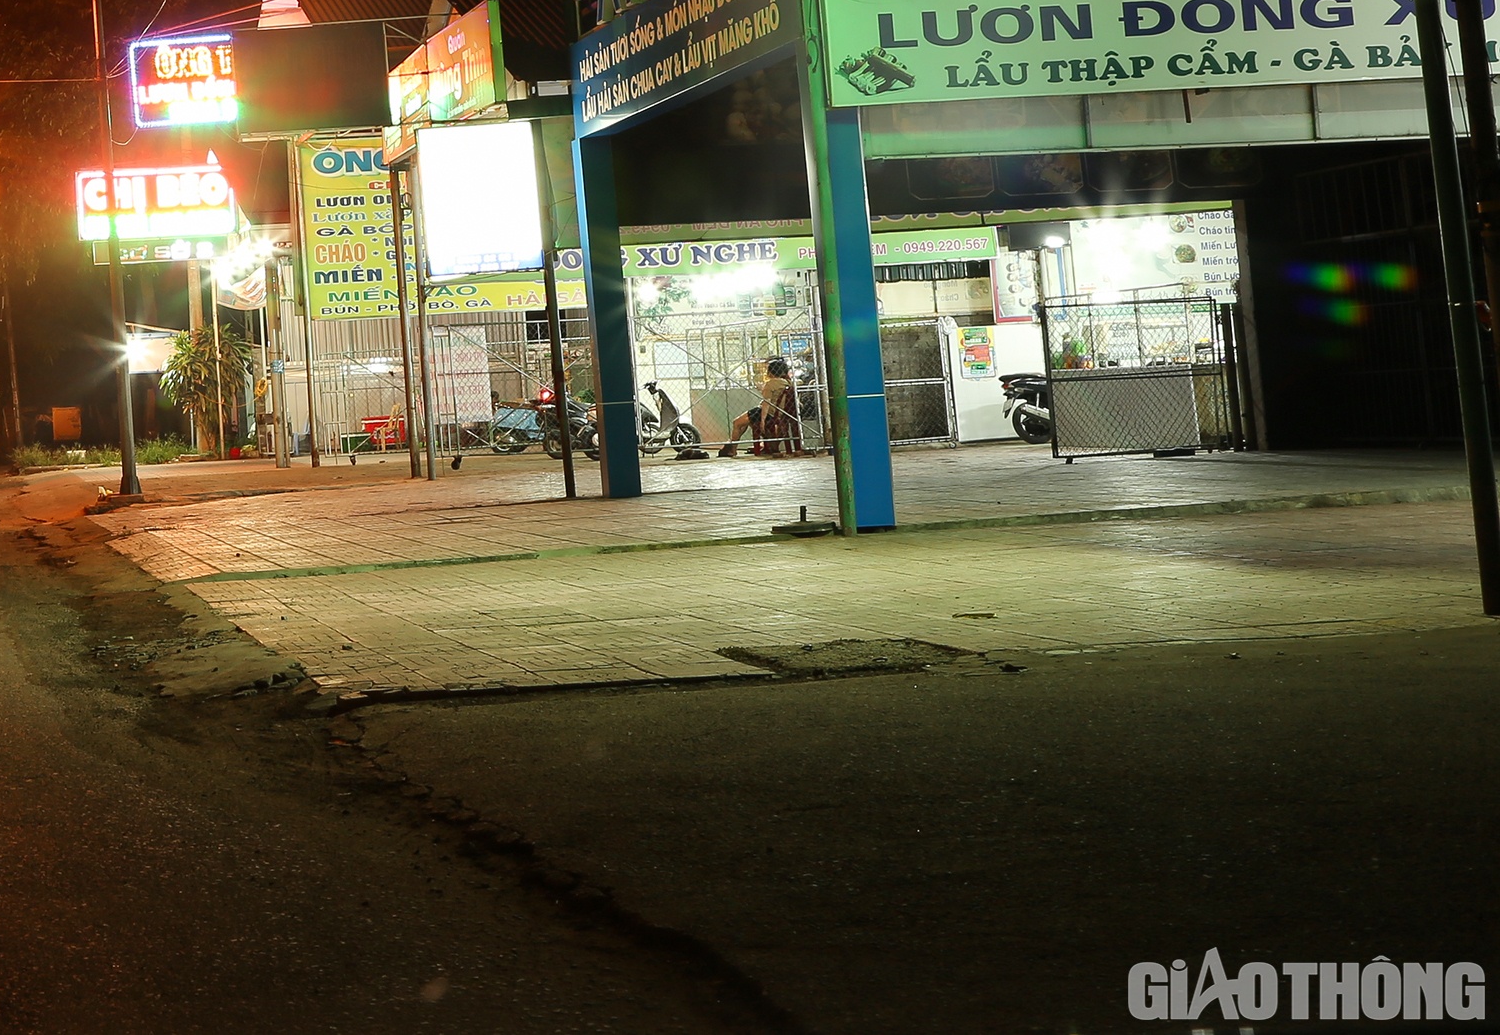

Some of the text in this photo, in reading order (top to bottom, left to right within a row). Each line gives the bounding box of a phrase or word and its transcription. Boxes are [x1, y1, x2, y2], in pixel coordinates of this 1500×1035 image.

[877, 4, 1094, 48] LƯƠN
[579, 50, 594, 83] HẢI
[594, 42, 611, 75] SẢN
[656, 17, 664, 41] &
[664, 0, 687, 37] MÓN
[582, 86, 597, 123] LẨU
[597, 81, 613, 116] HẢI
[612, 73, 630, 108] SẢN
[630, 67, 655, 99] CHUA
[655, 55, 674, 87] CAY
[674, 52, 681, 78] &
[681, 31, 701, 74] LẨU
[701, 33, 717, 68] VỊT
[718, 18, 753, 57] MĂNG
[945, 50, 1030, 88] LẨU
[1041, 50, 1155, 87] THẬP
[1167, 38, 1259, 77] CẨM
[1293, 41, 1355, 72] GÀ
[1366, 35, 1423, 69] BẢ
[316, 225, 354, 237] GÀ
[315, 240, 366, 264] CHÁO
[904, 238, 988, 254] 0949.220.567
[314, 265, 382, 284] MIẾN
[1204, 272, 1222, 281] Bún
[557, 288, 585, 303] SẢ
[321, 305, 359, 315] BÚN
[465, 297, 492, 308] GÀ
